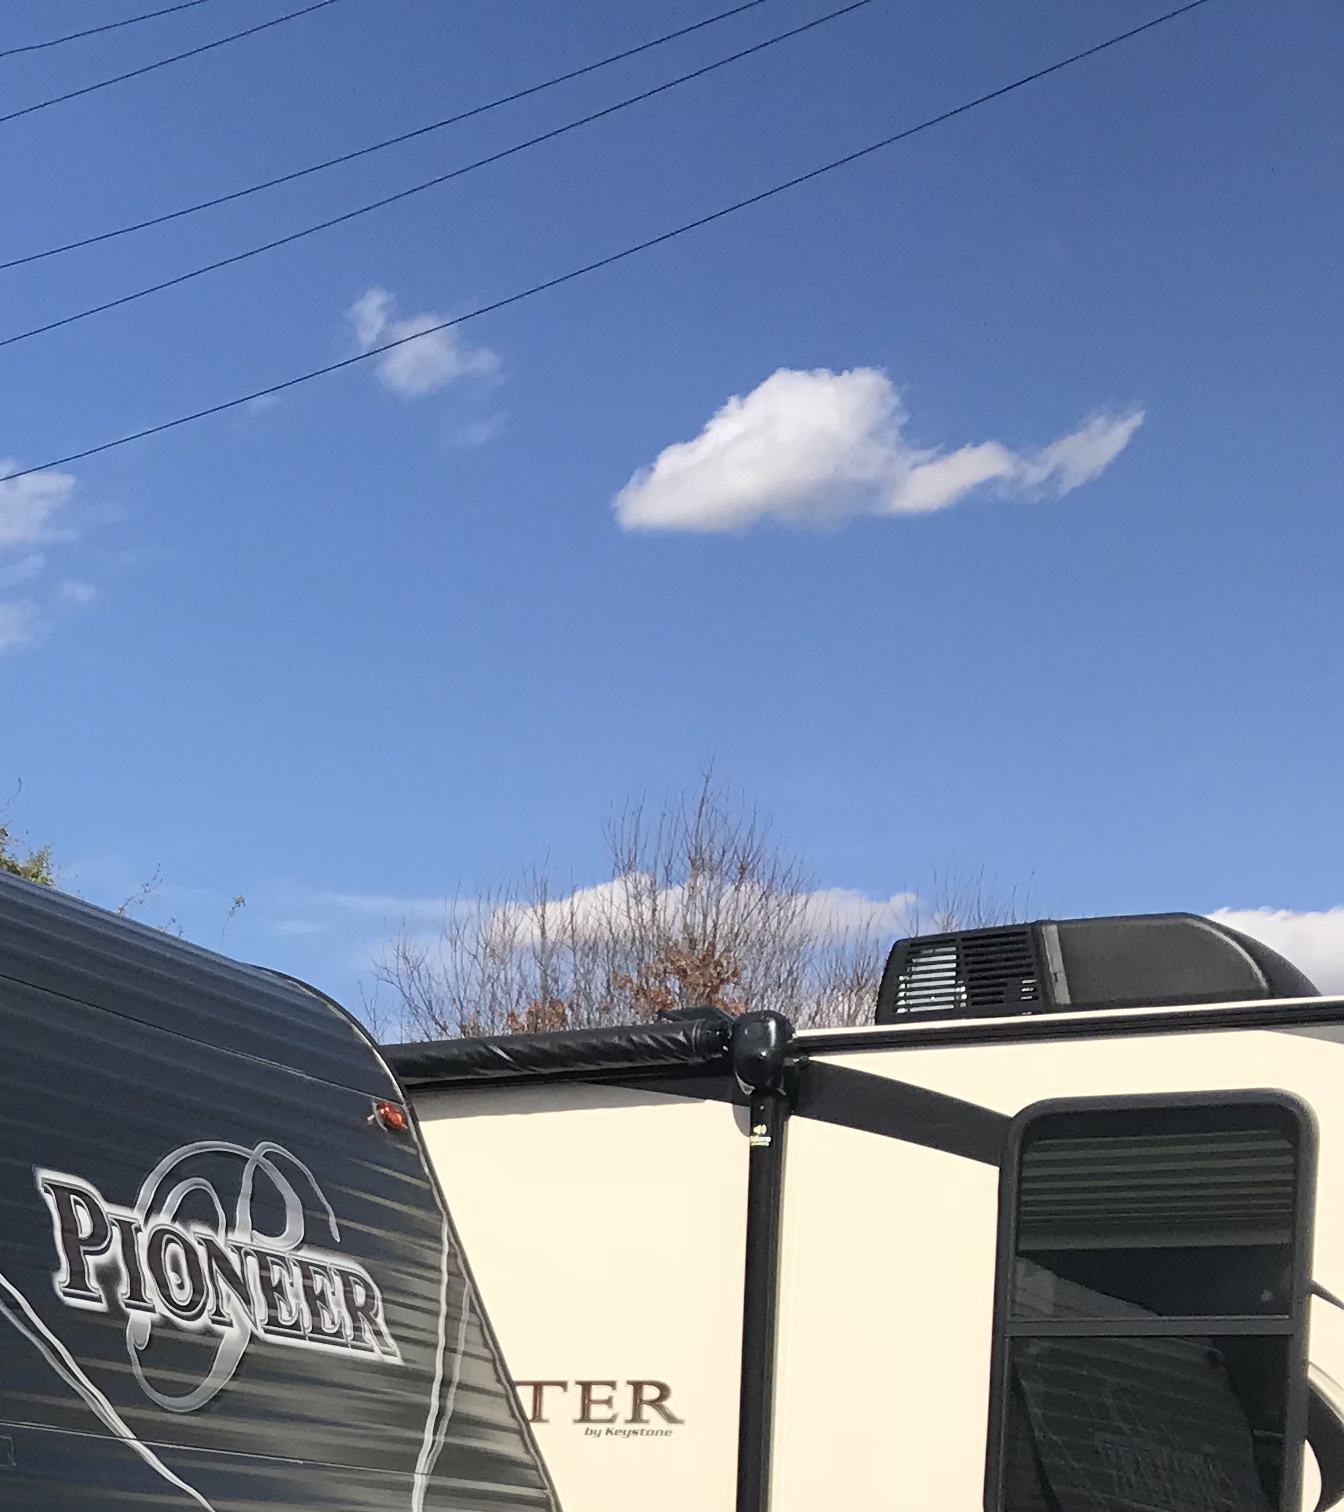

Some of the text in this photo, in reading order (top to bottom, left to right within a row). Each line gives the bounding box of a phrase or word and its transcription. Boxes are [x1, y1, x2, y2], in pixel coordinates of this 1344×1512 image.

[40, 1180, 398, 1362] PIONEER
[512, 1379, 686, 1424] TER
[584, 1427, 673, 1438] by Keystone
